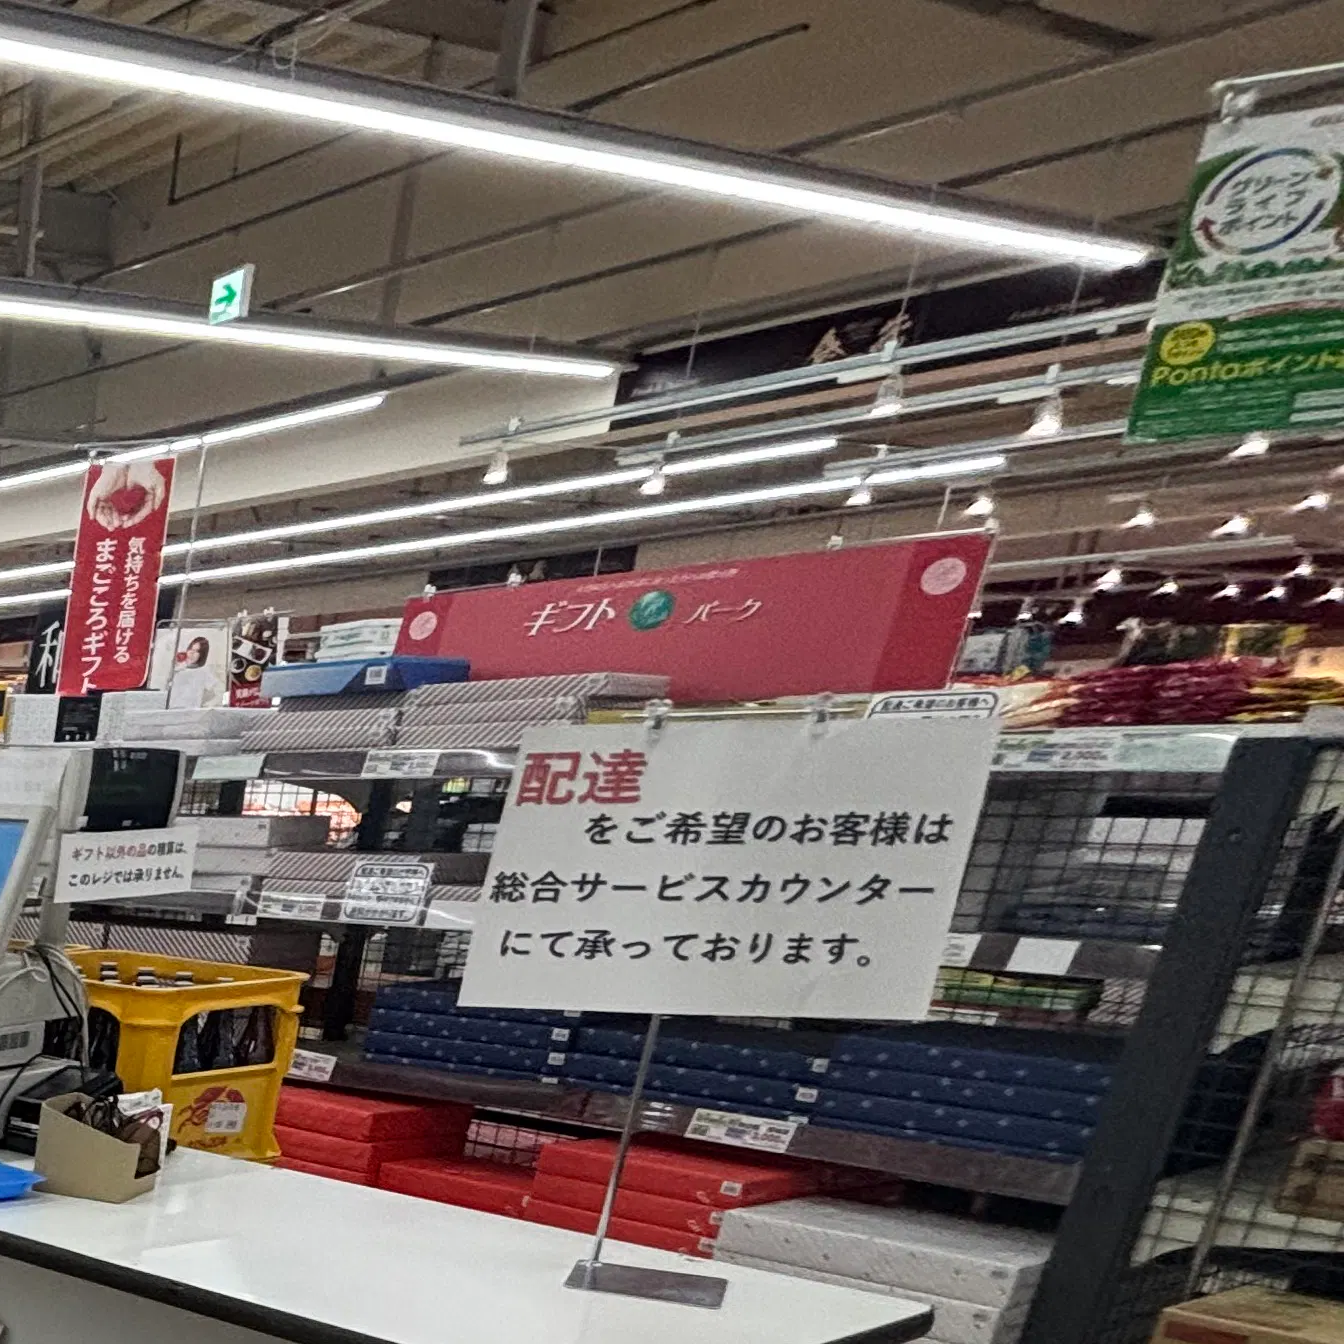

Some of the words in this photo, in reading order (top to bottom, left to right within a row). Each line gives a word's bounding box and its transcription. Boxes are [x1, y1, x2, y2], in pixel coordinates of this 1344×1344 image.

[80, 539, 118, 694] まごころギフト
[112, 536, 146, 664] 気持ちを届ける
[524, 597, 615, 637] ギフト
[683, 600, 763, 624] パーク
[515, 748, 649, 807] 配達
[584, 810, 953, 847] をご希望のお客様は
[69, 866, 184, 887] このレジでは承りません。
[489, 870, 935, 904] 総合サービスカウンター
[500, 929, 873, 968] にて承っております。
